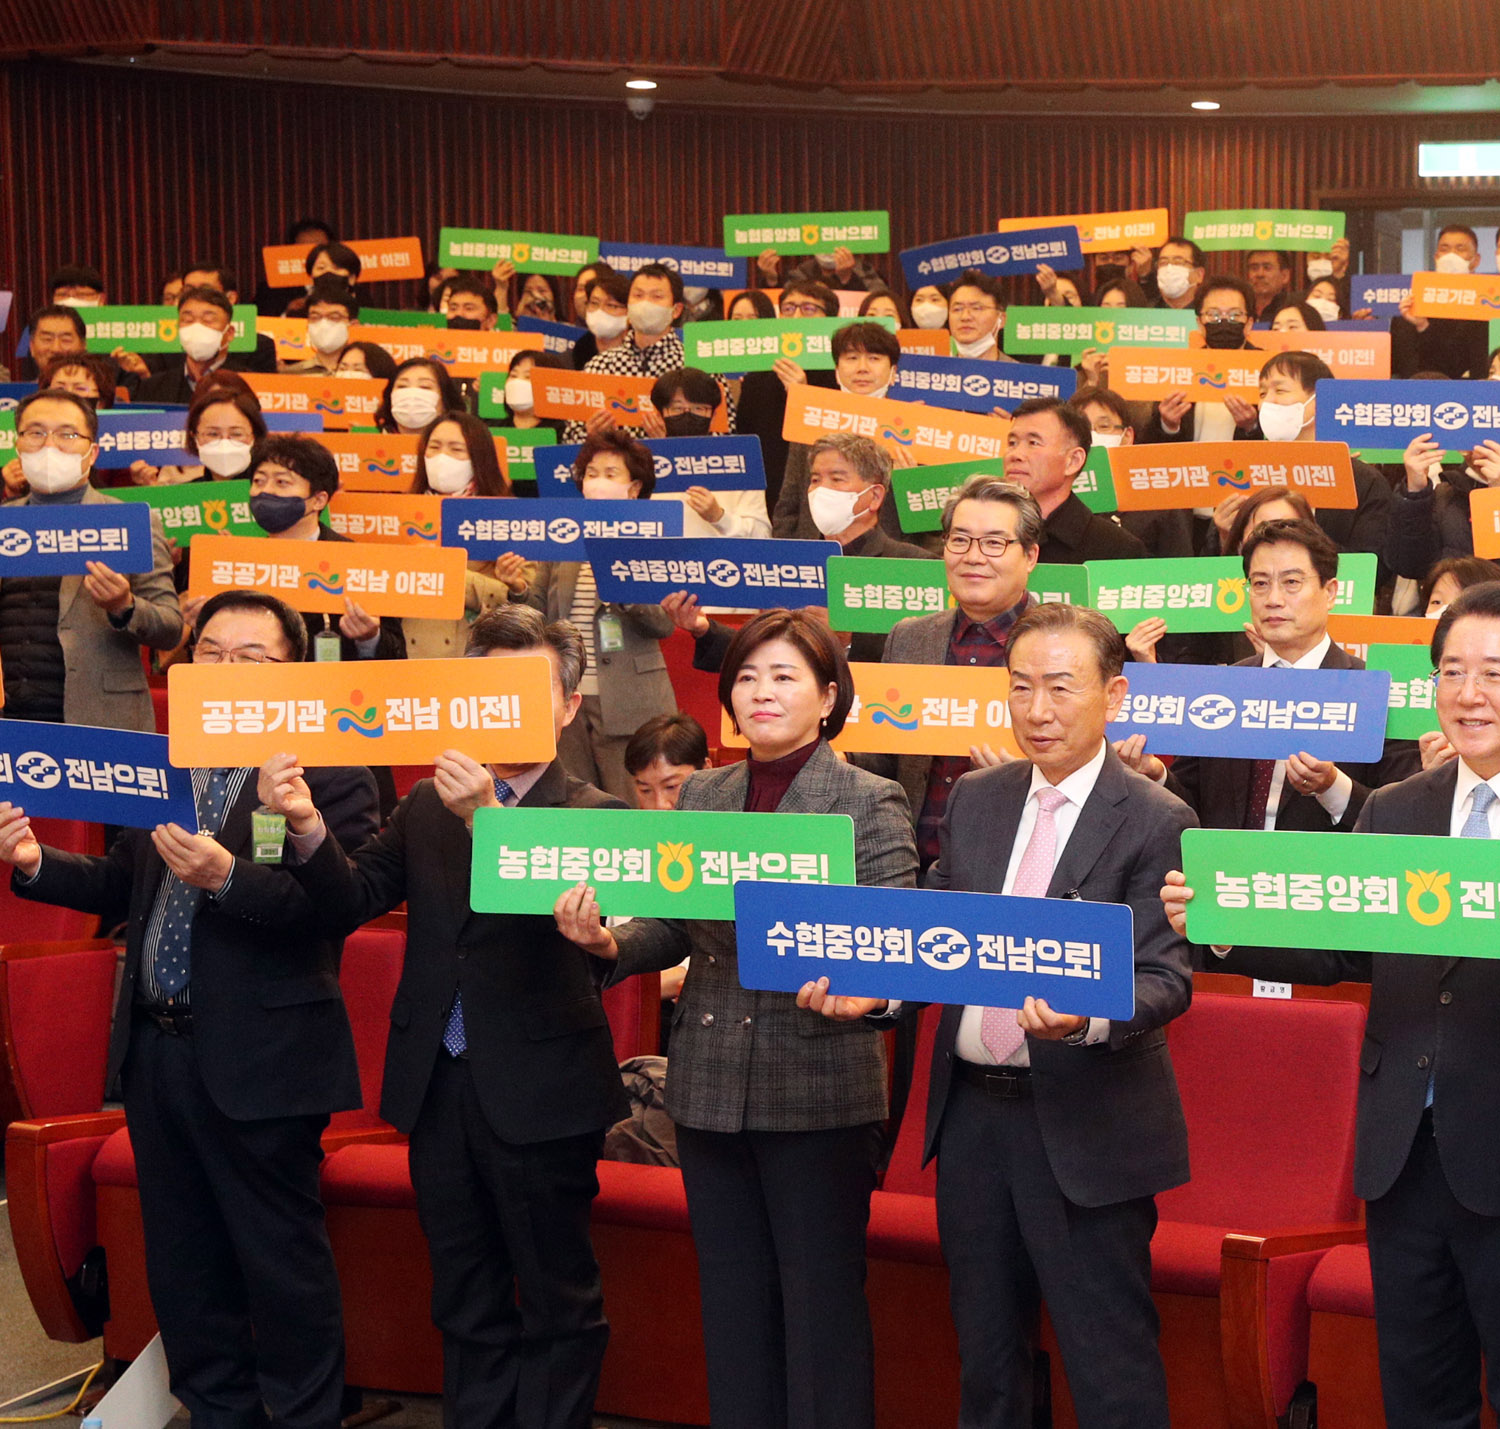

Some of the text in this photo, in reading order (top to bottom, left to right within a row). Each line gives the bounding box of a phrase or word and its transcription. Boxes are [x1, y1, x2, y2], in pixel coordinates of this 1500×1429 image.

[735, 226, 878, 244] 농협중앙회 전남으로!
[1094, 223, 1155, 240] 전남 이전!
[1193, 222, 1333, 240] 농협중앙회 전남으로!
[380, 252, 410, 268] 이전!
[450, 241, 588, 265] 농협중앙회 전남으로!
[917, 241, 1068, 275] 수협중앙회 전남으로!
[680, 260, 733, 277] 전남으로!
[1363, 288, 1412, 304] 수협중앙
[1423, 287, 1475, 305] 공공기관
[1016, 323, 1186, 343] 농협중앙회 전남으로!
[457, 347, 489, 364] 전남
[697, 338, 779, 358] 농협중앙회
[1339, 349, 1375, 366] 이전!
[894, 370, 962, 393] 협중앙회
[1125, 366, 1260, 388] 공공기관 전남
[256, 392, 379, 414] 공기관 전남
[546, 385, 606, 409] 공공기관
[1334, 402, 1431, 427] 수협중앙회
[99, 430, 187, 451] 수협중앙회
[804, 406, 1000, 458] 공공기관 전남 이전!
[673, 455, 746, 475] 전남으로!
[1129, 465, 1336, 490] 공공기관 전남 이전!
[331, 514, 400, 536] 공공기관
[458, 520, 545, 542] 수협중앙회
[36, 527, 128, 553] 전남으로!
[212, 559, 444, 597] 공공기관 전남 이전!
[610, 559, 825, 590] 수협중앙회 전남으로!
[843, 583, 944, 611] 농협중앙회
[1097, 584, 1212, 611] 농협중앙회
[201, 694, 521, 735] 공공기관 전남 이전!
[920, 697, 978, 727] 전남
[1240, 698, 1356, 732] 전남으로!
[64, 757, 169, 800] 전남으로!
[497, 843, 829, 885] 농협중앙회 전남으로!
[1214, 870, 1399, 915] 농협중앙회
[765, 920, 1102, 981] 수협중앙회 전남으로!
